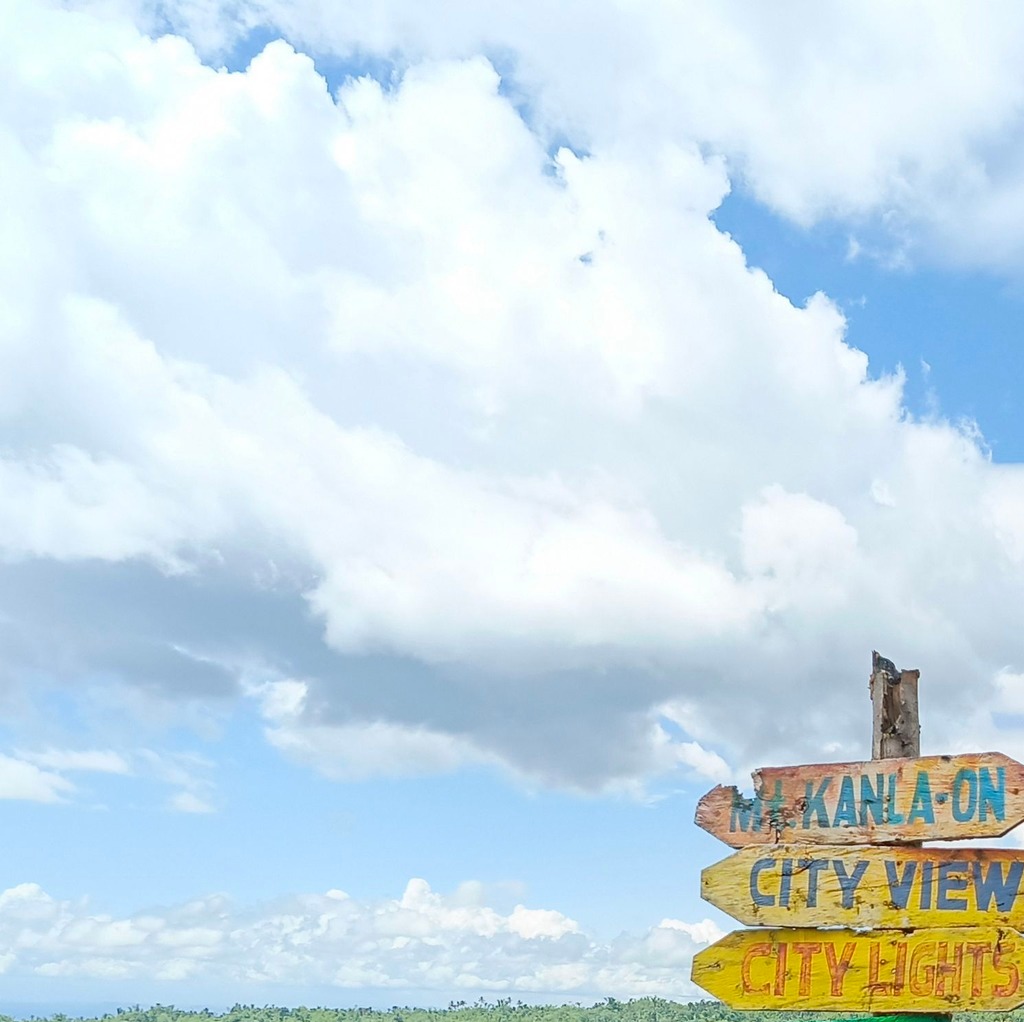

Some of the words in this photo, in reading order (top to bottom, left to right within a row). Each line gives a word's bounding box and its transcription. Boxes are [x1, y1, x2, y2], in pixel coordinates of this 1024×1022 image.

[802, 766, 1006, 830] KANLA-ON
[749, 858, 870, 910] CITY
[884, 860, 1024, 913] VIEW
[741, 942, 854, 997] CITY
[868, 941, 1020, 998] LIGHTS
